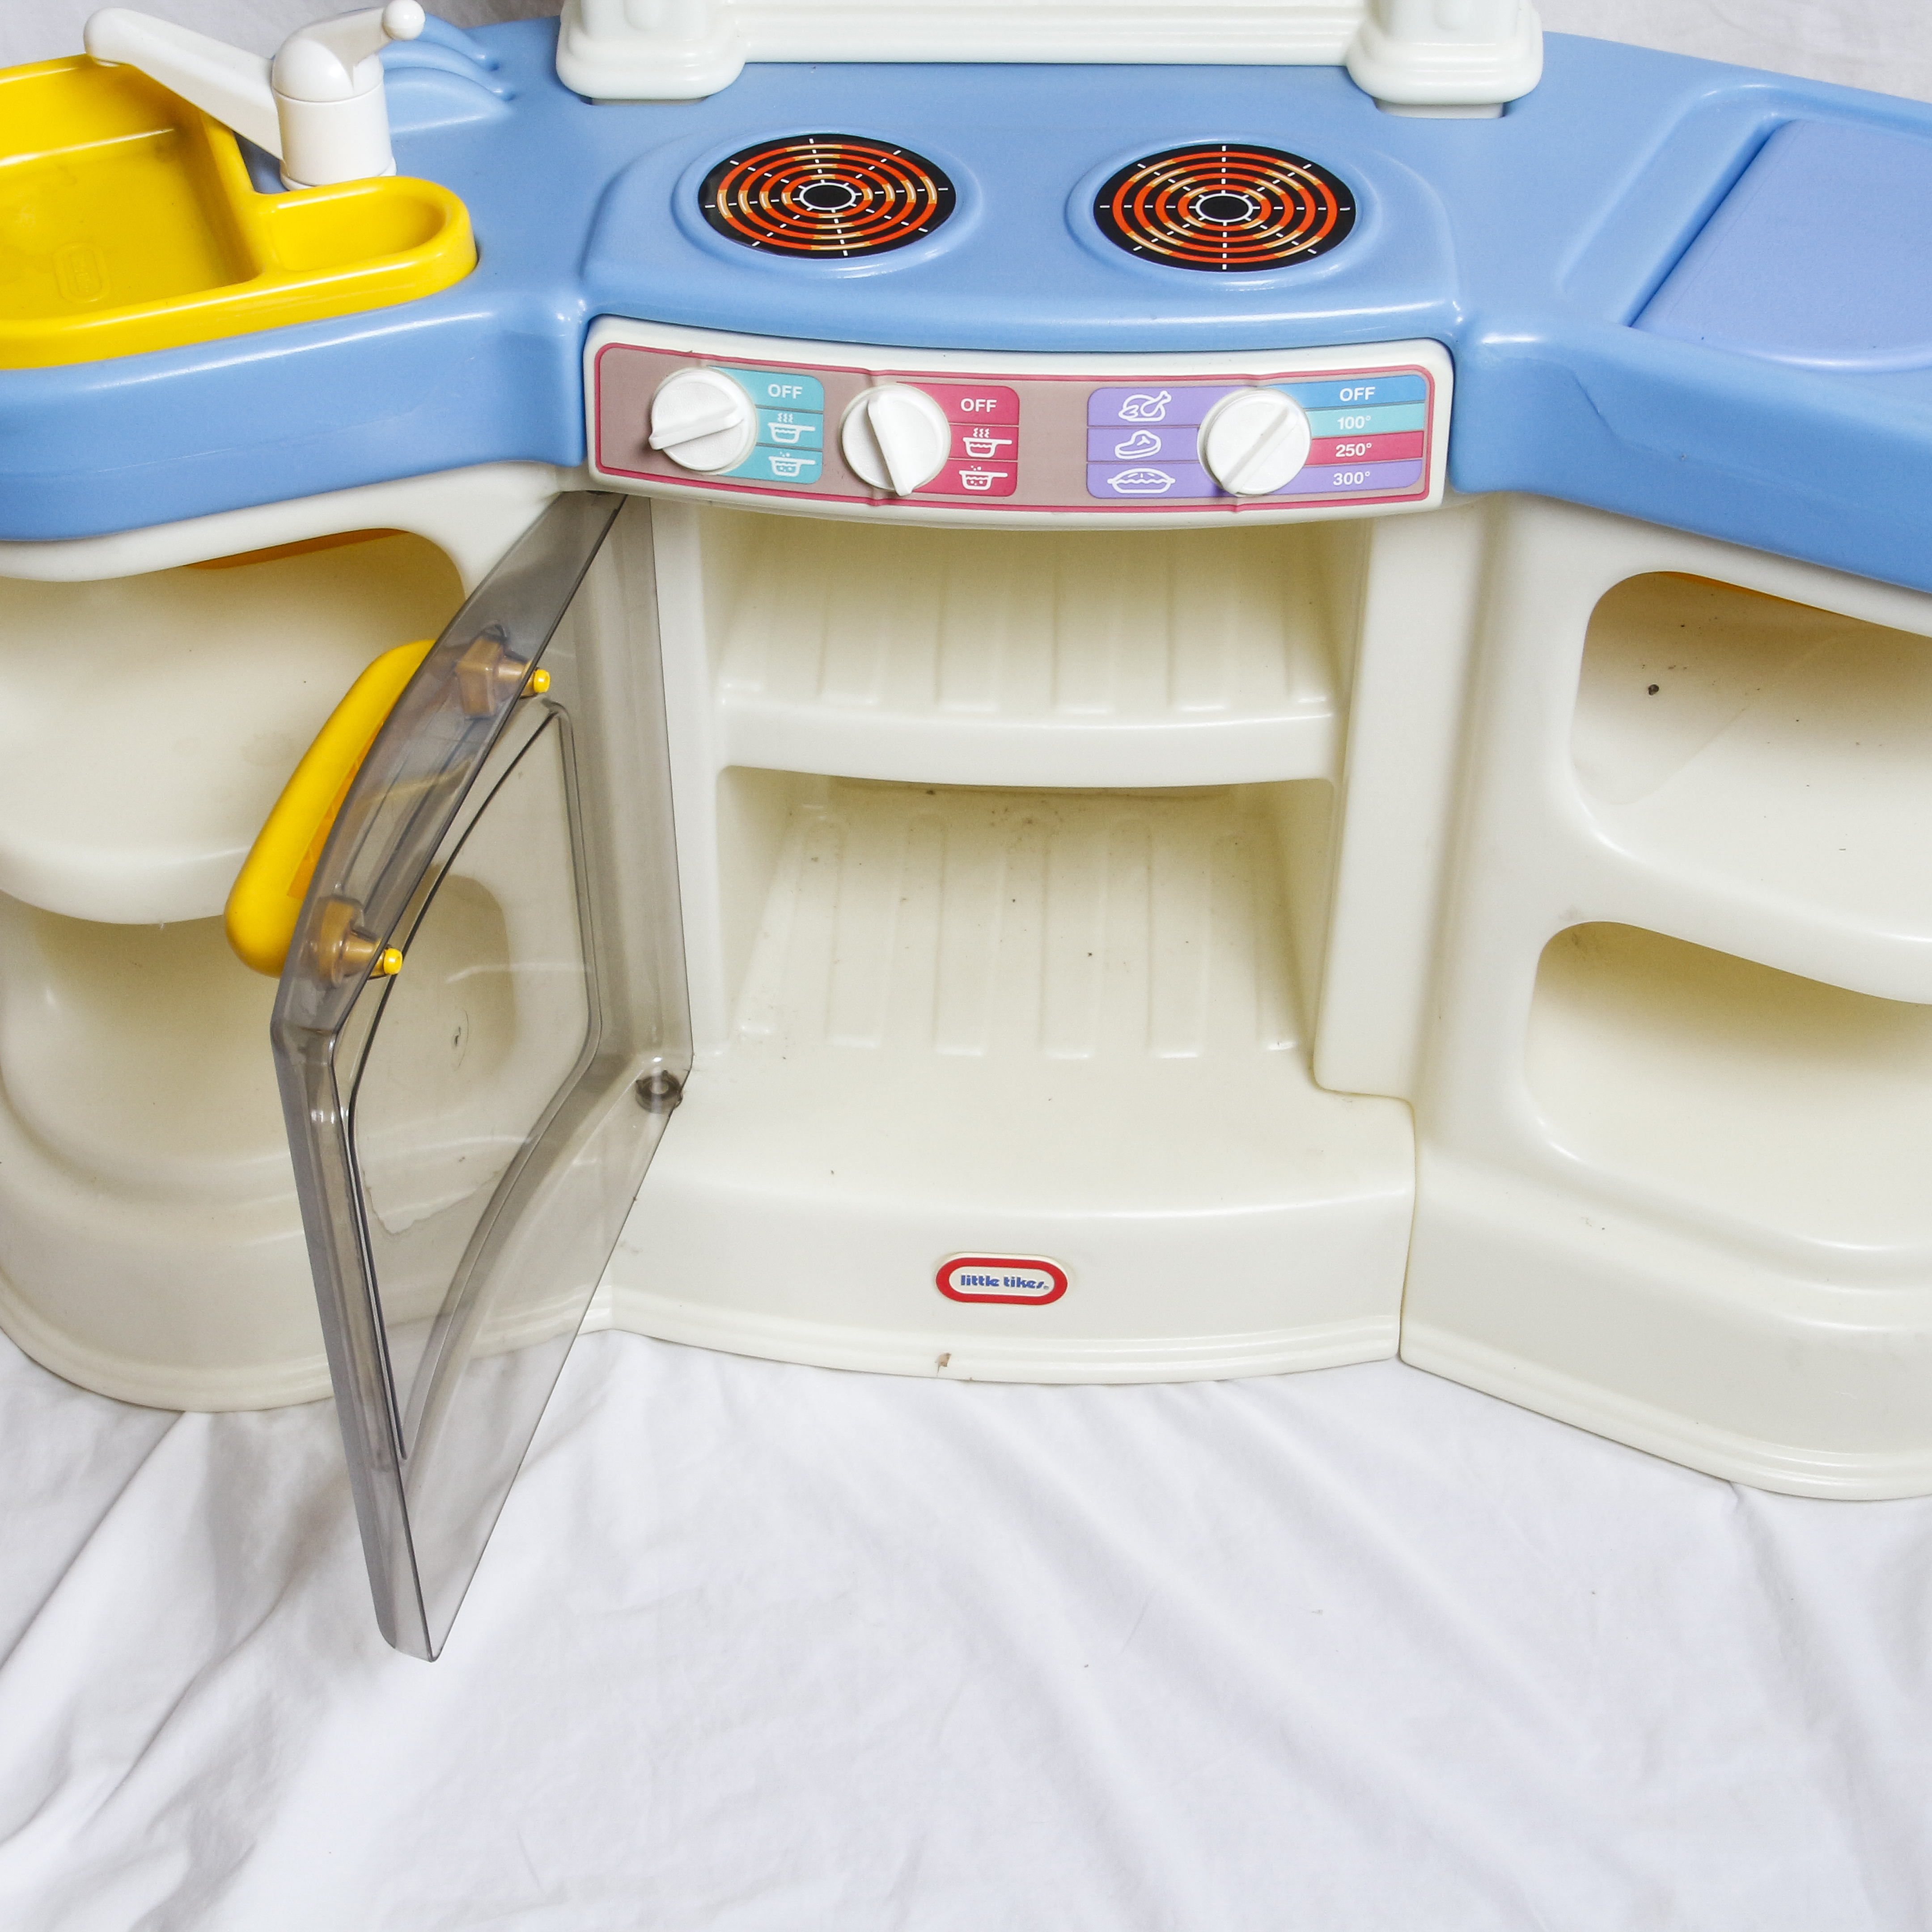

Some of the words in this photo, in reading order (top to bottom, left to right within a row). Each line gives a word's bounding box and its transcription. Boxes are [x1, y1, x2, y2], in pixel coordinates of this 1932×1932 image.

[767, 383, 803, 399] OFF
[1339, 386, 1376, 402] OFF
[960, 398, 997, 413] OFF
[1337, 415, 1371, 430] 100°
[1335, 442, 1372, 458] 250°
[1333, 471, 1370, 486] 300°
[961, 1275, 999, 1287] little
